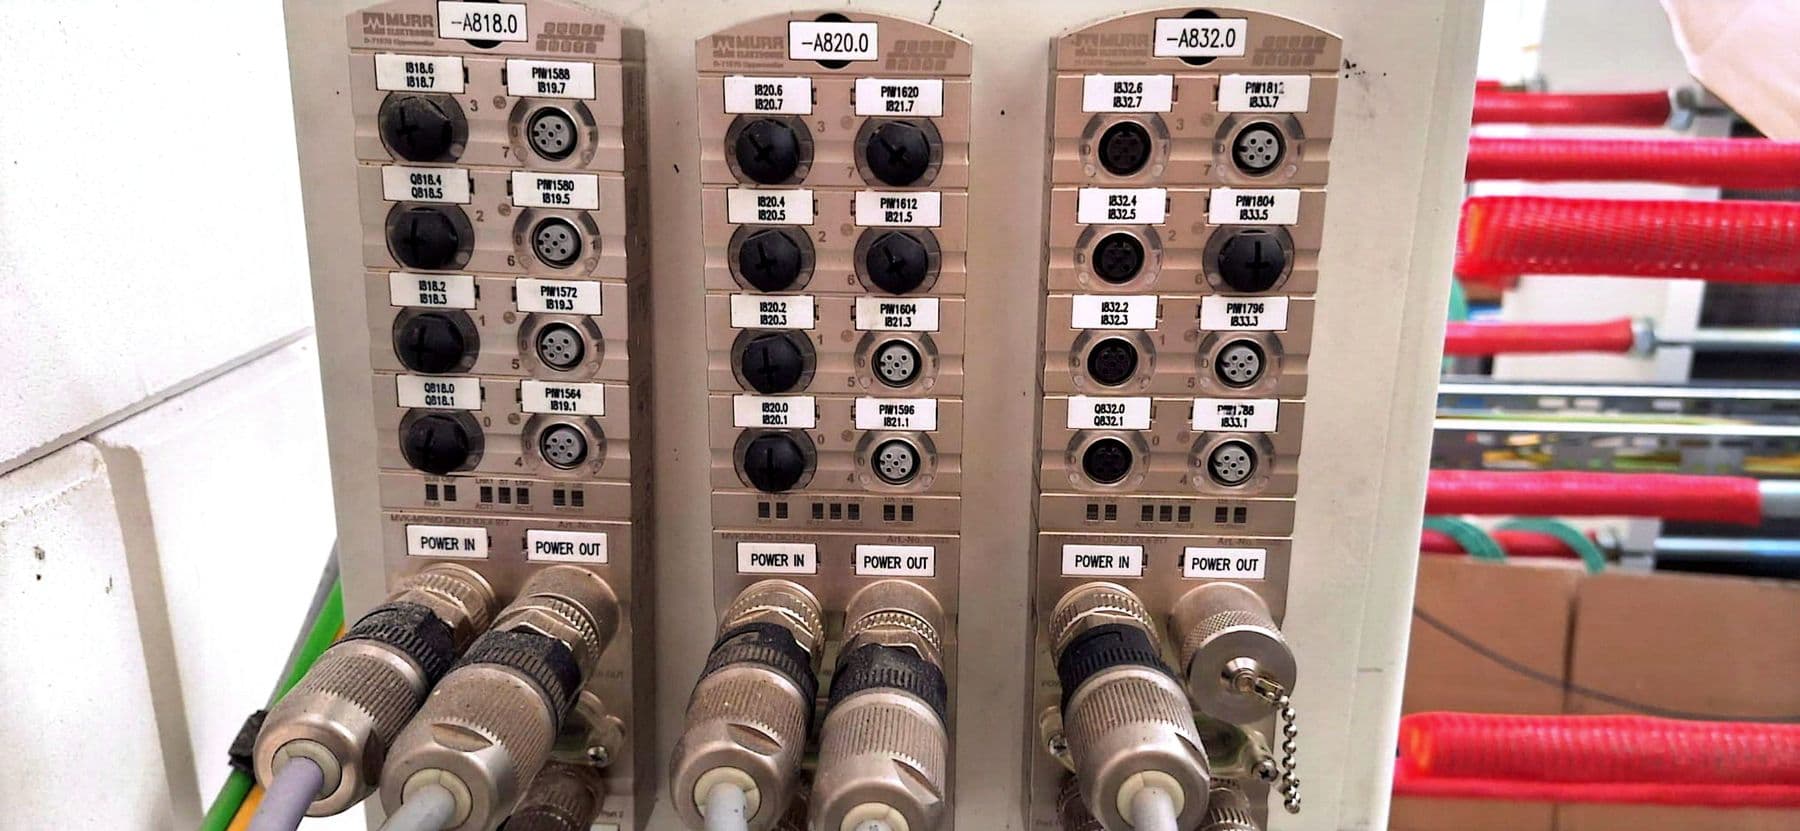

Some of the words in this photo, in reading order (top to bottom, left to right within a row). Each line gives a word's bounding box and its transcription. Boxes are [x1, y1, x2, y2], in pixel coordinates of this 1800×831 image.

[386, 12, 434, 27] MURR
[452, 13, 517, 33] -A818.0
[802, 33, 868, 52] -A820.0
[1167, 28, 1235, 48] -A832.0
[406, 62, 434, 74] I818.6
[407, 76, 434, 88] I818.7
[538, 81, 565, 94] I819.7
[1114, 82, 1142, 94] I832.6
[755, 84, 782, 96] I820.6
[755, 98, 783, 110] I820.7
[886, 100, 914, 112] I821.7
[1113, 96, 1142, 108] I832.7
[1249, 96, 1279, 108] I833.7
[410, 173, 442, 187] Q818.4
[411, 187, 443, 199] Q818.5
[542, 193, 570, 204] I819.5
[758, 196, 785, 209] I820.4
[1109, 195, 1136, 206] I832.4
[758, 209, 785, 221] I820.5
[885, 211, 912, 222] I821.5
[1108, 209, 1136, 219] I832.5
[1240, 209, 1268, 220] I833.5
[418, 280, 446, 293] I818.2
[419, 293, 447, 305] I818.3
[546, 299, 573, 310] I819.3
[760, 302, 787, 314] I820.2
[1102, 302, 1128, 312] I832.2
[760, 314, 787, 325] I820.3
[885, 316, 911, 327] I821.3
[1101, 315, 1128, 325] I832.3
[1231, 316, 1258, 326] I833.3
[424, 382, 455, 394] Q818.0
[424, 395, 454, 407] Q818.1
[551, 400, 576, 411] I819.1
[762, 402, 788, 414] I820.0
[1095, 404, 1125, 414] Q832.0
[762, 414, 787, 425] I820.1
[884, 417, 909, 428] I821.1
[1094, 416, 1123, 426] Q832.1
[1221, 417, 1247, 427] I833.1
[421, 536, 459, 550] POWER
[464, 538, 475, 551] IN
[536, 541, 573, 555] POWER
[579, 543, 600, 556] OUT
[751, 553, 788, 566] POWER
[794, 554, 804, 567] IN
[864, 556, 901, 569] POWER
[907, 557, 928, 569] OUT
[1075, 555, 1113, 568] POWER
[1119, 556, 1129, 568] IN
[1192, 558, 1230, 571] POWER
[1236, 559, 1258, 571] OUT
